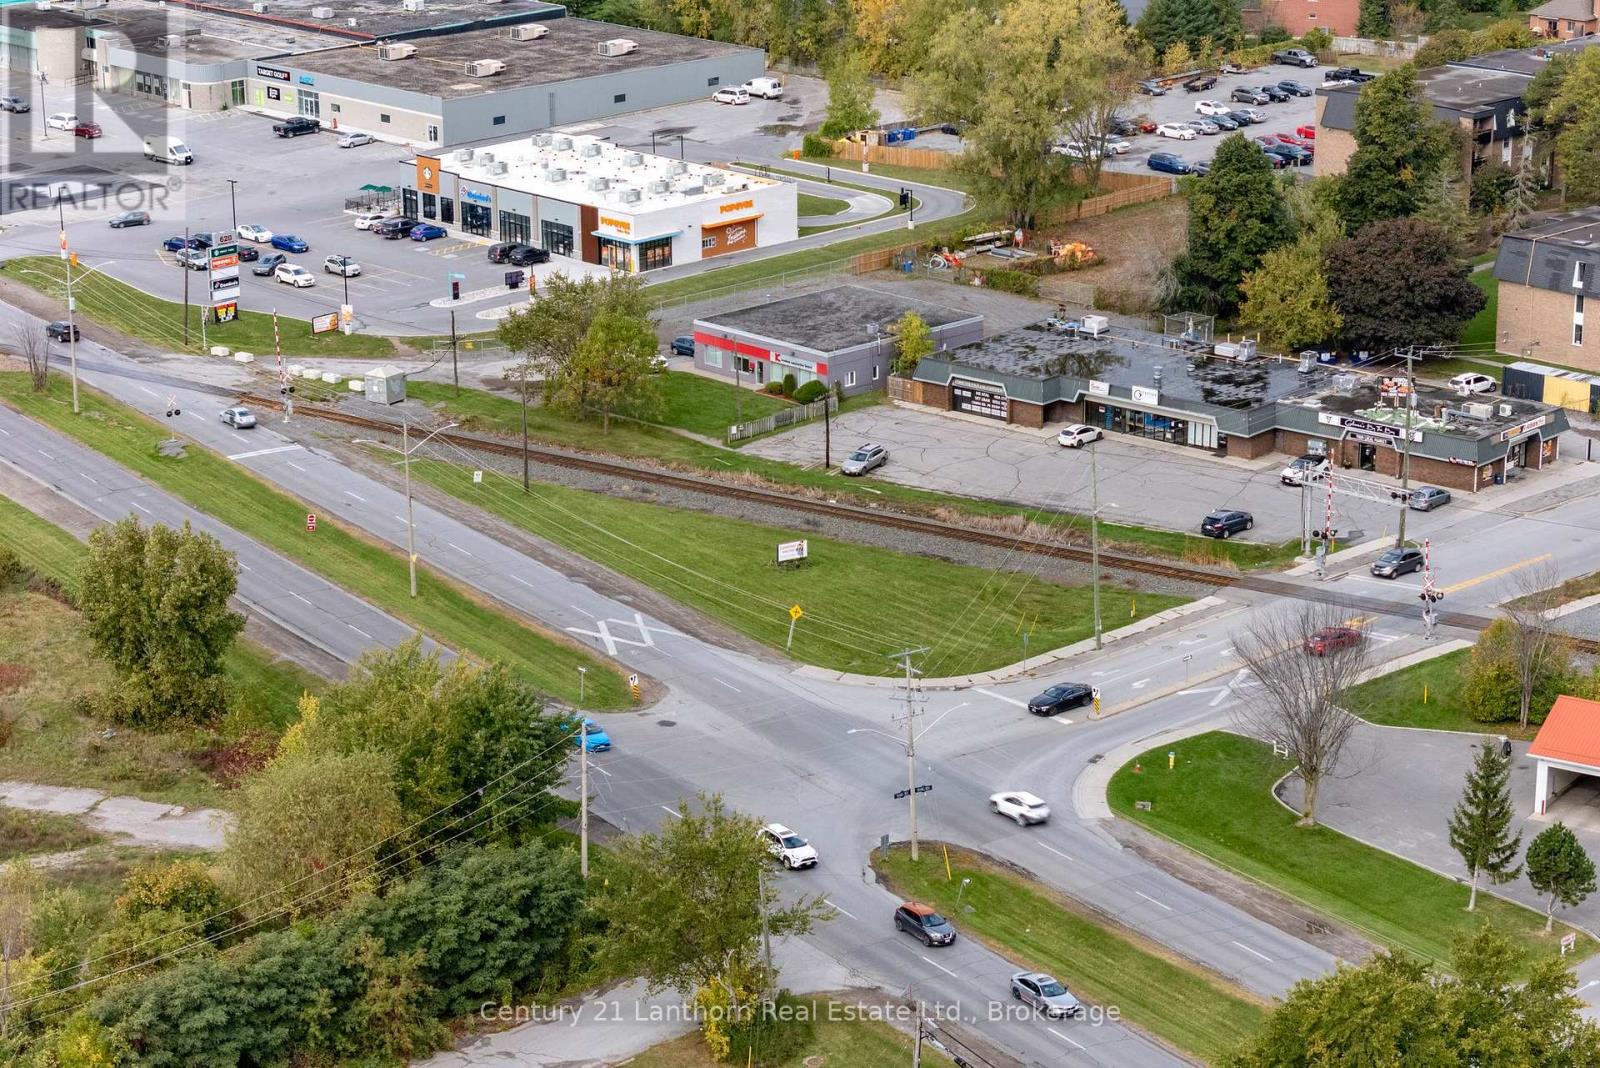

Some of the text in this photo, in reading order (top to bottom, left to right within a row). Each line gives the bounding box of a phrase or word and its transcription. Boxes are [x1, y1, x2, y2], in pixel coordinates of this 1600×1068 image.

[257, 68, 284, 79] TARGET GOLF
[219, 234, 233, 243] 620
